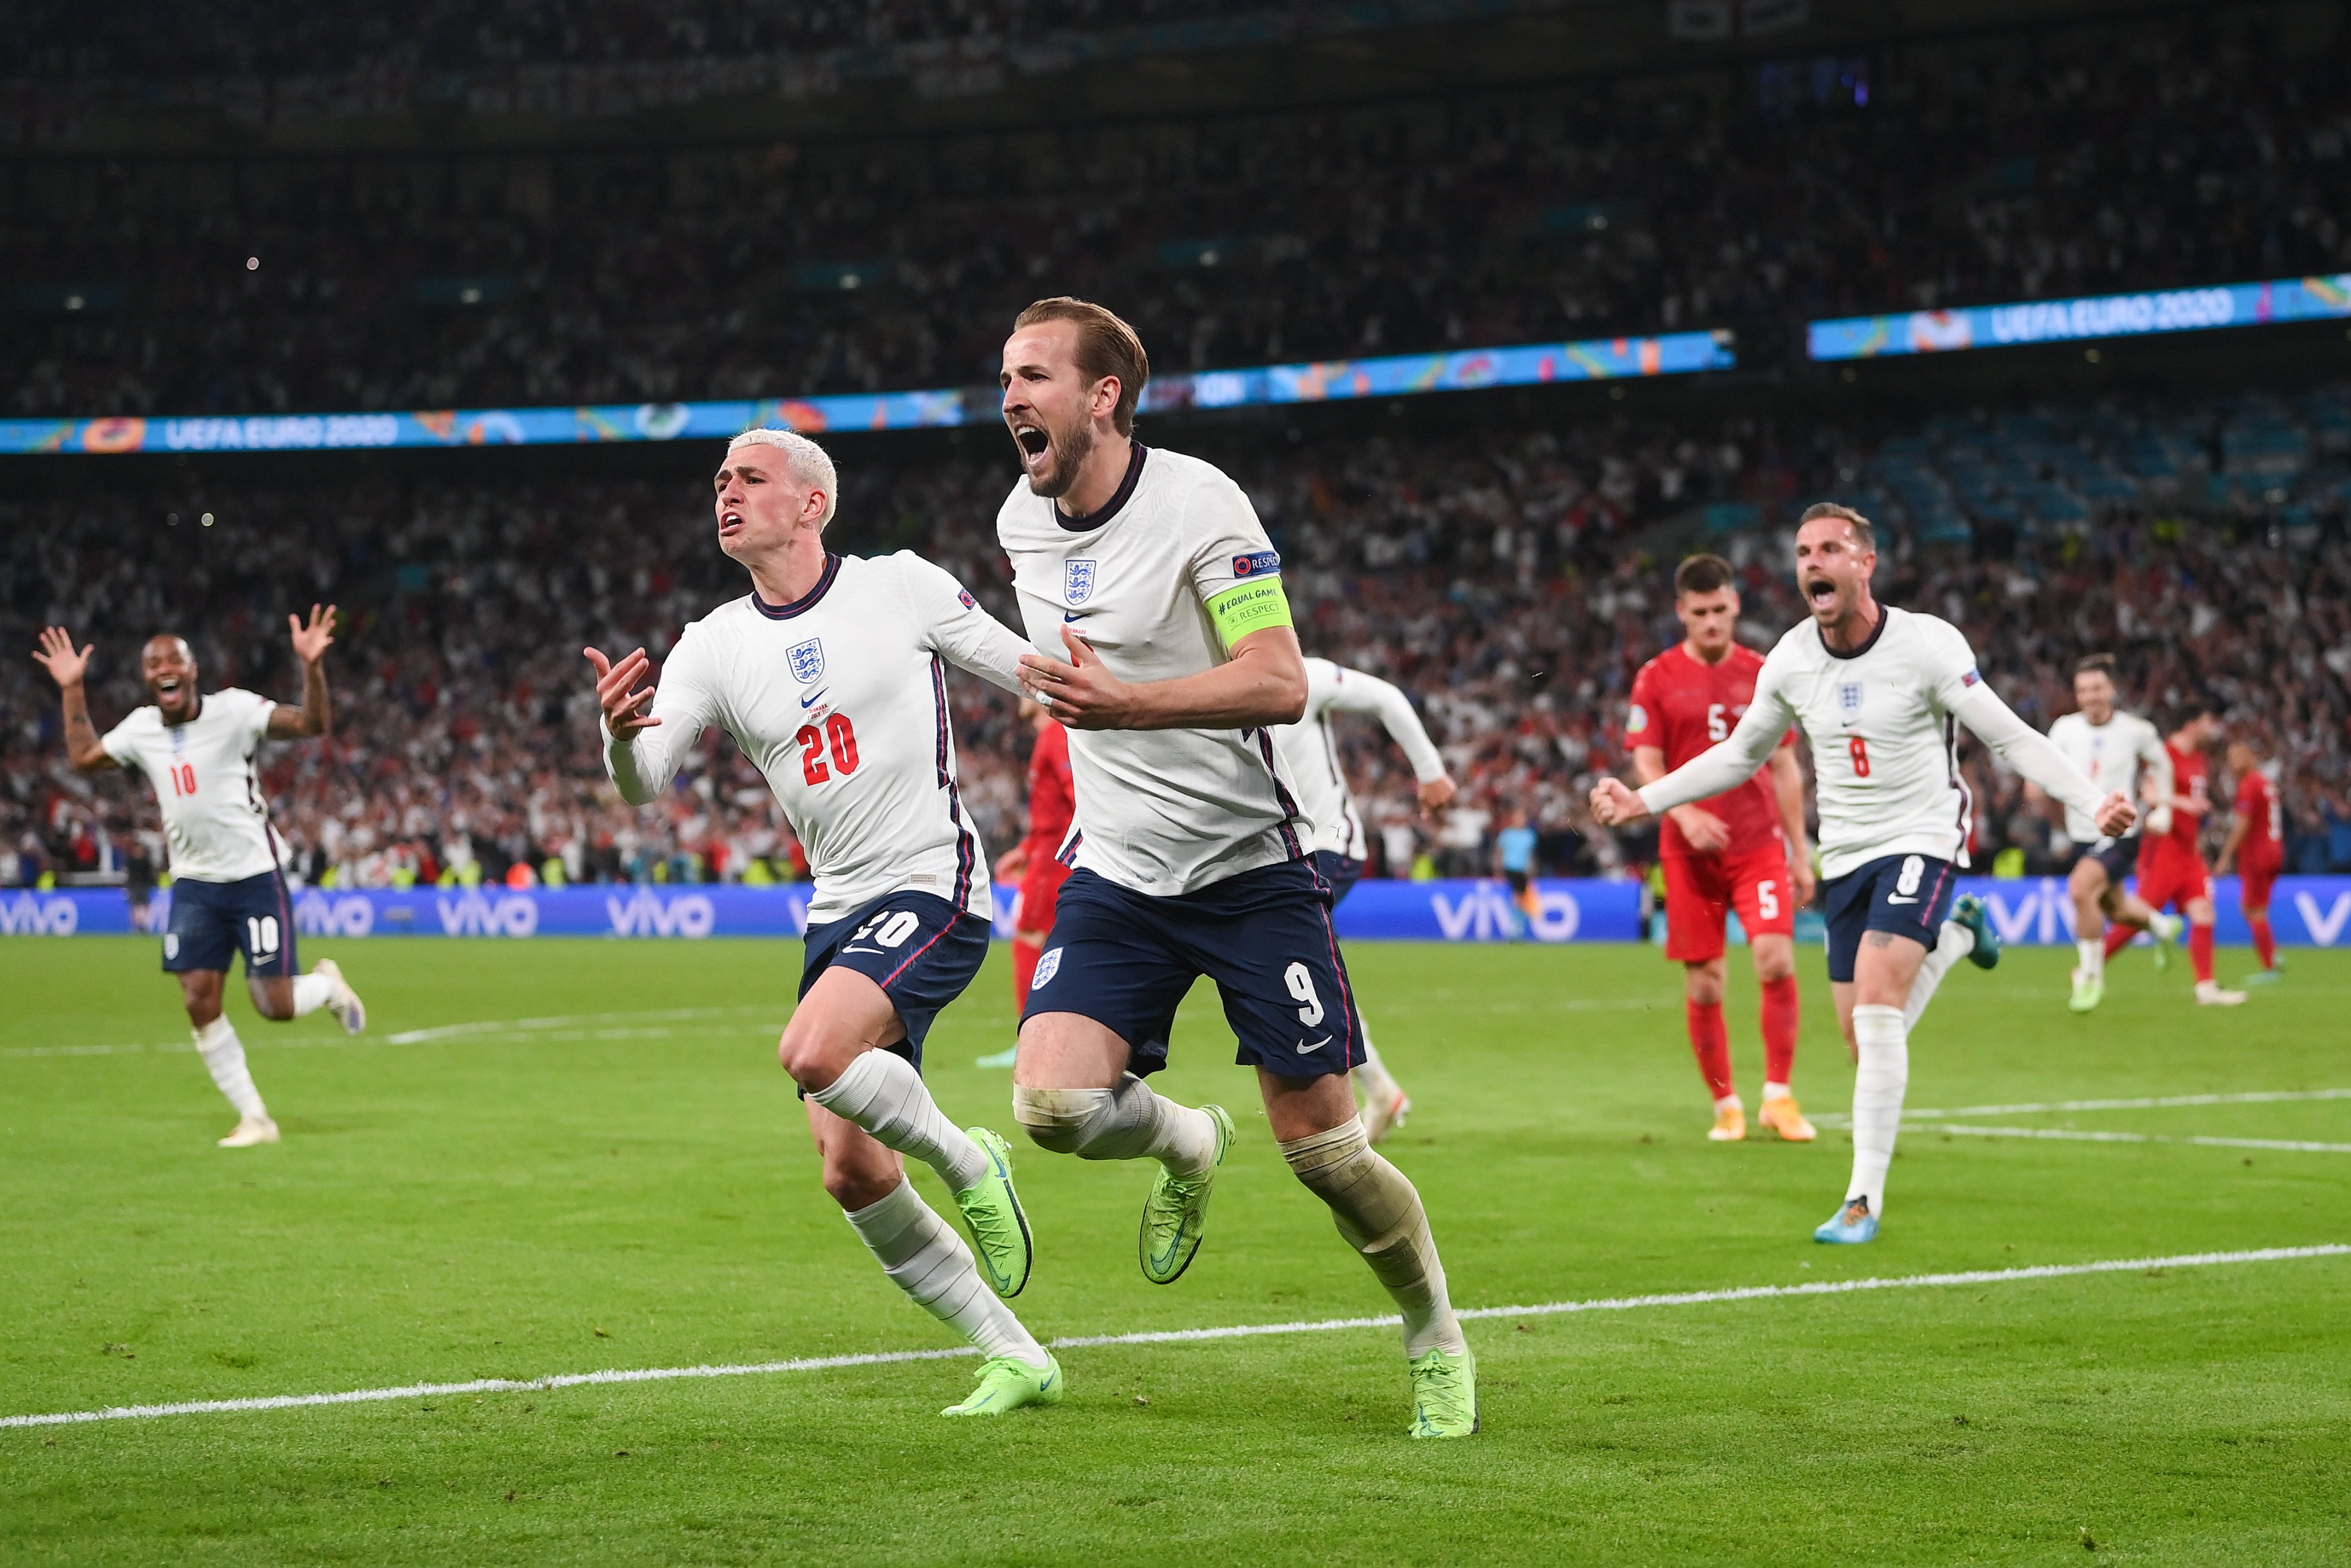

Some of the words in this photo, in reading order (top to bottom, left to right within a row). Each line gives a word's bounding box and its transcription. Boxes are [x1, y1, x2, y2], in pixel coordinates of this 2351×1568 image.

[1991, 302, 2069, 343] UEFA
[2070, 294, 2153, 337] EURO
[2155, 287, 2234, 330] 2020
[165, 417, 243, 451] UEFA
[245, 416, 324, 449] EURO
[325, 414, 398, 447] 2020
[1252, 556, 1278, 569] RESPEC
[1218, 592, 1254, 617] #EQUAL
[1256, 588, 1278, 598] GAME
[1239, 603, 1279, 620] RESPECT
[1708, 703, 1728, 743] 5
[796, 713, 860, 786] 20
[1849, 737, 1869, 777] 8
[171, 763, 197, 797] 10
[1896, 855, 1925, 896] 8
[1757, 880, 1779, 919] 5
[246, 916, 279, 954] 10
[851, 911, 920, 948] 20
[1284, 962, 1324, 1027] 9
